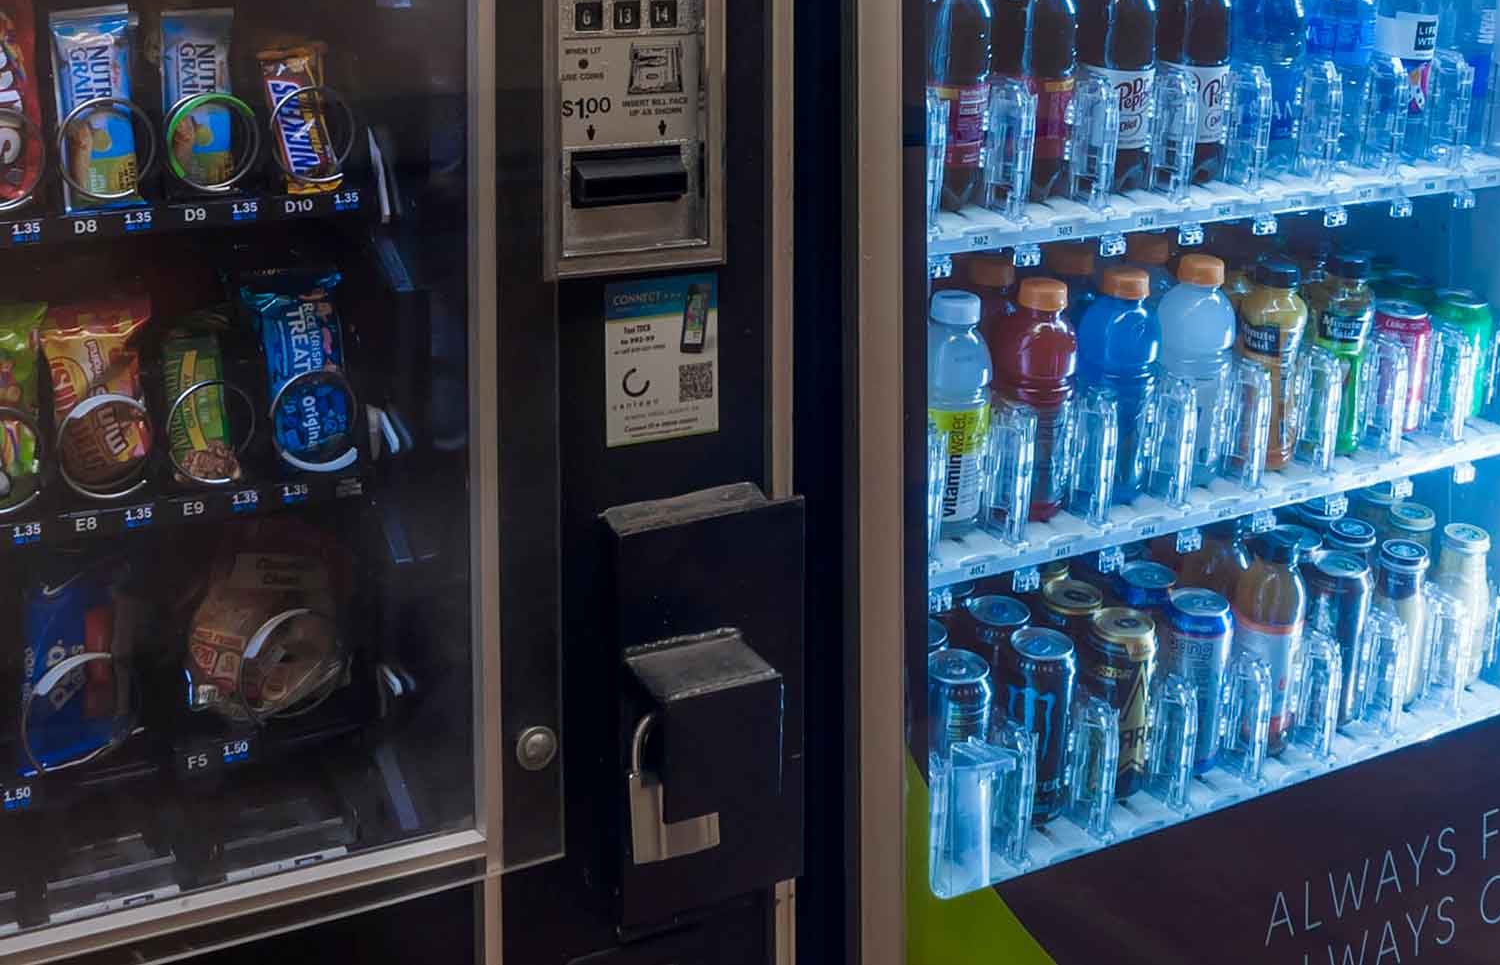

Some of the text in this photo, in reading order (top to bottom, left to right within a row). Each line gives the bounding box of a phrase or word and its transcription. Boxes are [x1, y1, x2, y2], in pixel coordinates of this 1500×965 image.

[583, 7, 668, 25] G 13 14
[93, 45, 113, 100] NUTR
[180, 43, 197, 94] GRAI
[195, 44, 216, 94] NUTR
[562, 96, 612, 120] $1.00
[622, 99, 650, 108] INSERT
[334, 192, 360, 205] 1.35
[231, 202, 258, 215] 1.35
[284, 199, 313, 213] D10
[124, 212, 152, 225] 1.35
[184, 208, 207, 222] D9
[12, 223, 41, 236] 1.35
[74, 220, 97, 234] D8
[1057, 225, 1073, 236] 303
[972, 235, 989, 246] 302
[1322, 314, 1362, 330] Minute
[287, 308, 311, 372] TREAT
[301, 302, 323, 372] RICE KRISPI
[301, 394, 320, 450] origina
[232, 492, 259, 505] 1.35
[125, 507, 153, 521] 1.35
[183, 502, 205, 516] E9
[13, 523, 41, 537] 1.35
[75, 517, 97, 532] E8
[1055, 546, 1071, 557] 403
[969, 564, 986, 576] 402
[222, 740, 249, 755] 1.50
[187, 754, 209, 769] F5
[4, 786, 31, 801] 1.50
[1265, 827, 1457, 947] ALWAYS
